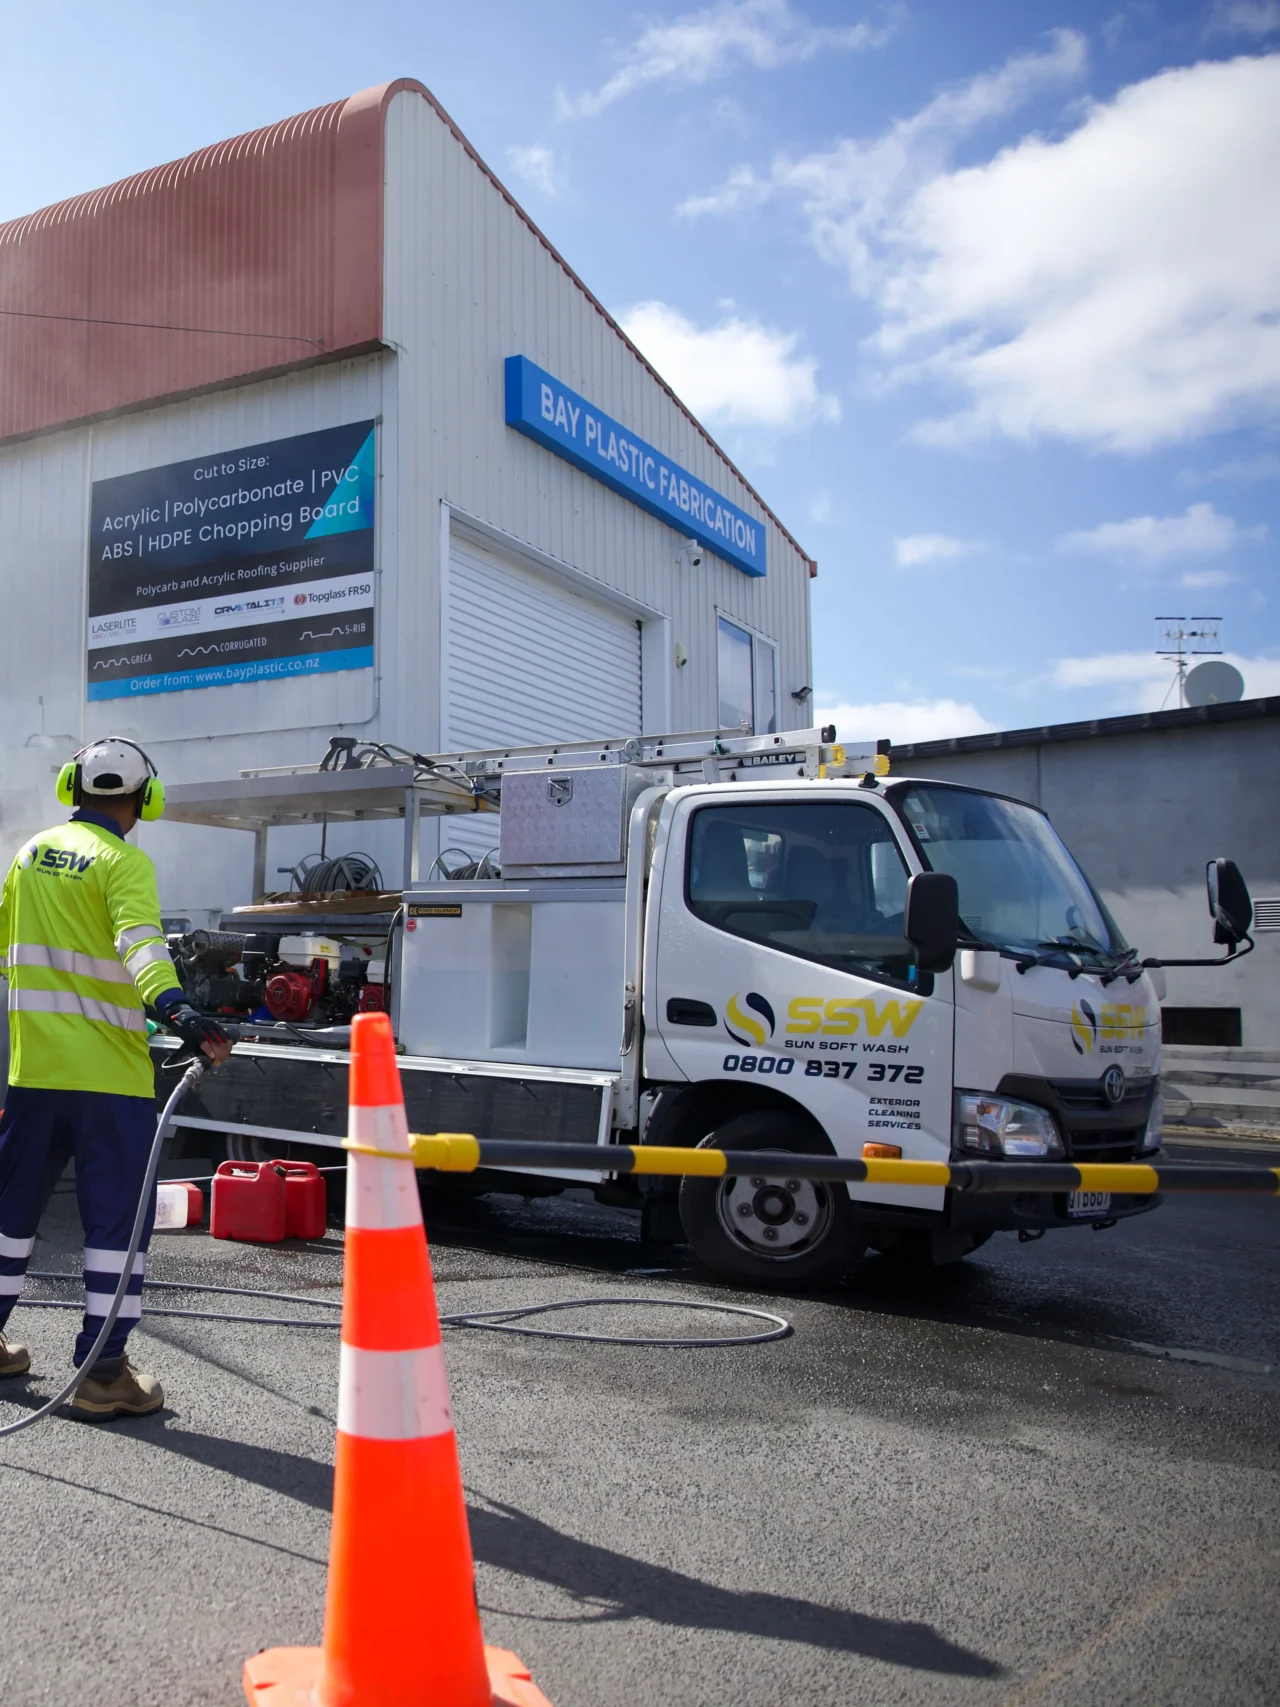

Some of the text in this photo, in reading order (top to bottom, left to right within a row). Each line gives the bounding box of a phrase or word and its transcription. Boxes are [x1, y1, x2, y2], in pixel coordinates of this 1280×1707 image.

[193, 456, 270, 481] Cut to Size:
[541, 383, 756, 556] BAY PLASTIC FABRICATION
[102, 507, 161, 532] Acrylic
[173, 479, 304, 517] Polycarbonate
[321, 465, 359, 488] PVC
[102, 541, 133, 560] ABS
[148, 529, 192, 551] HDPE
[199, 513, 293, 541] Chopping
[300, 496, 359, 523] Board
[136, 556, 325, 596] Polycarb and Acrylic Roofing Supplier
[308, 584, 370, 604] Topglass FR50
[92, 618, 137, 634] LASERLITE
[169, 614, 200, 625] GLAZE
[344, 622, 366, 635] 5-RIB
[220, 637, 267, 652] CORRUGATED
[131, 653, 152, 665] GRECA
[130, 656, 320, 691] Order from: www.bayplastic.co.nz
[753, 754, 795, 765] BAILEY
[40, 848, 96, 873] SSW
[785, 996, 925, 1038] SSW
[1100, 1003, 1146, 1041] SSW
[784, 1040, 909, 1053] SUN SOFT WASH
[723, 1055, 925, 1084] 0800 837 372
[869, 1097, 921, 1107] EXTERIOR
[868, 1108, 921, 1118] CLEANING
[867, 1120, 921, 1130] SERVICES
